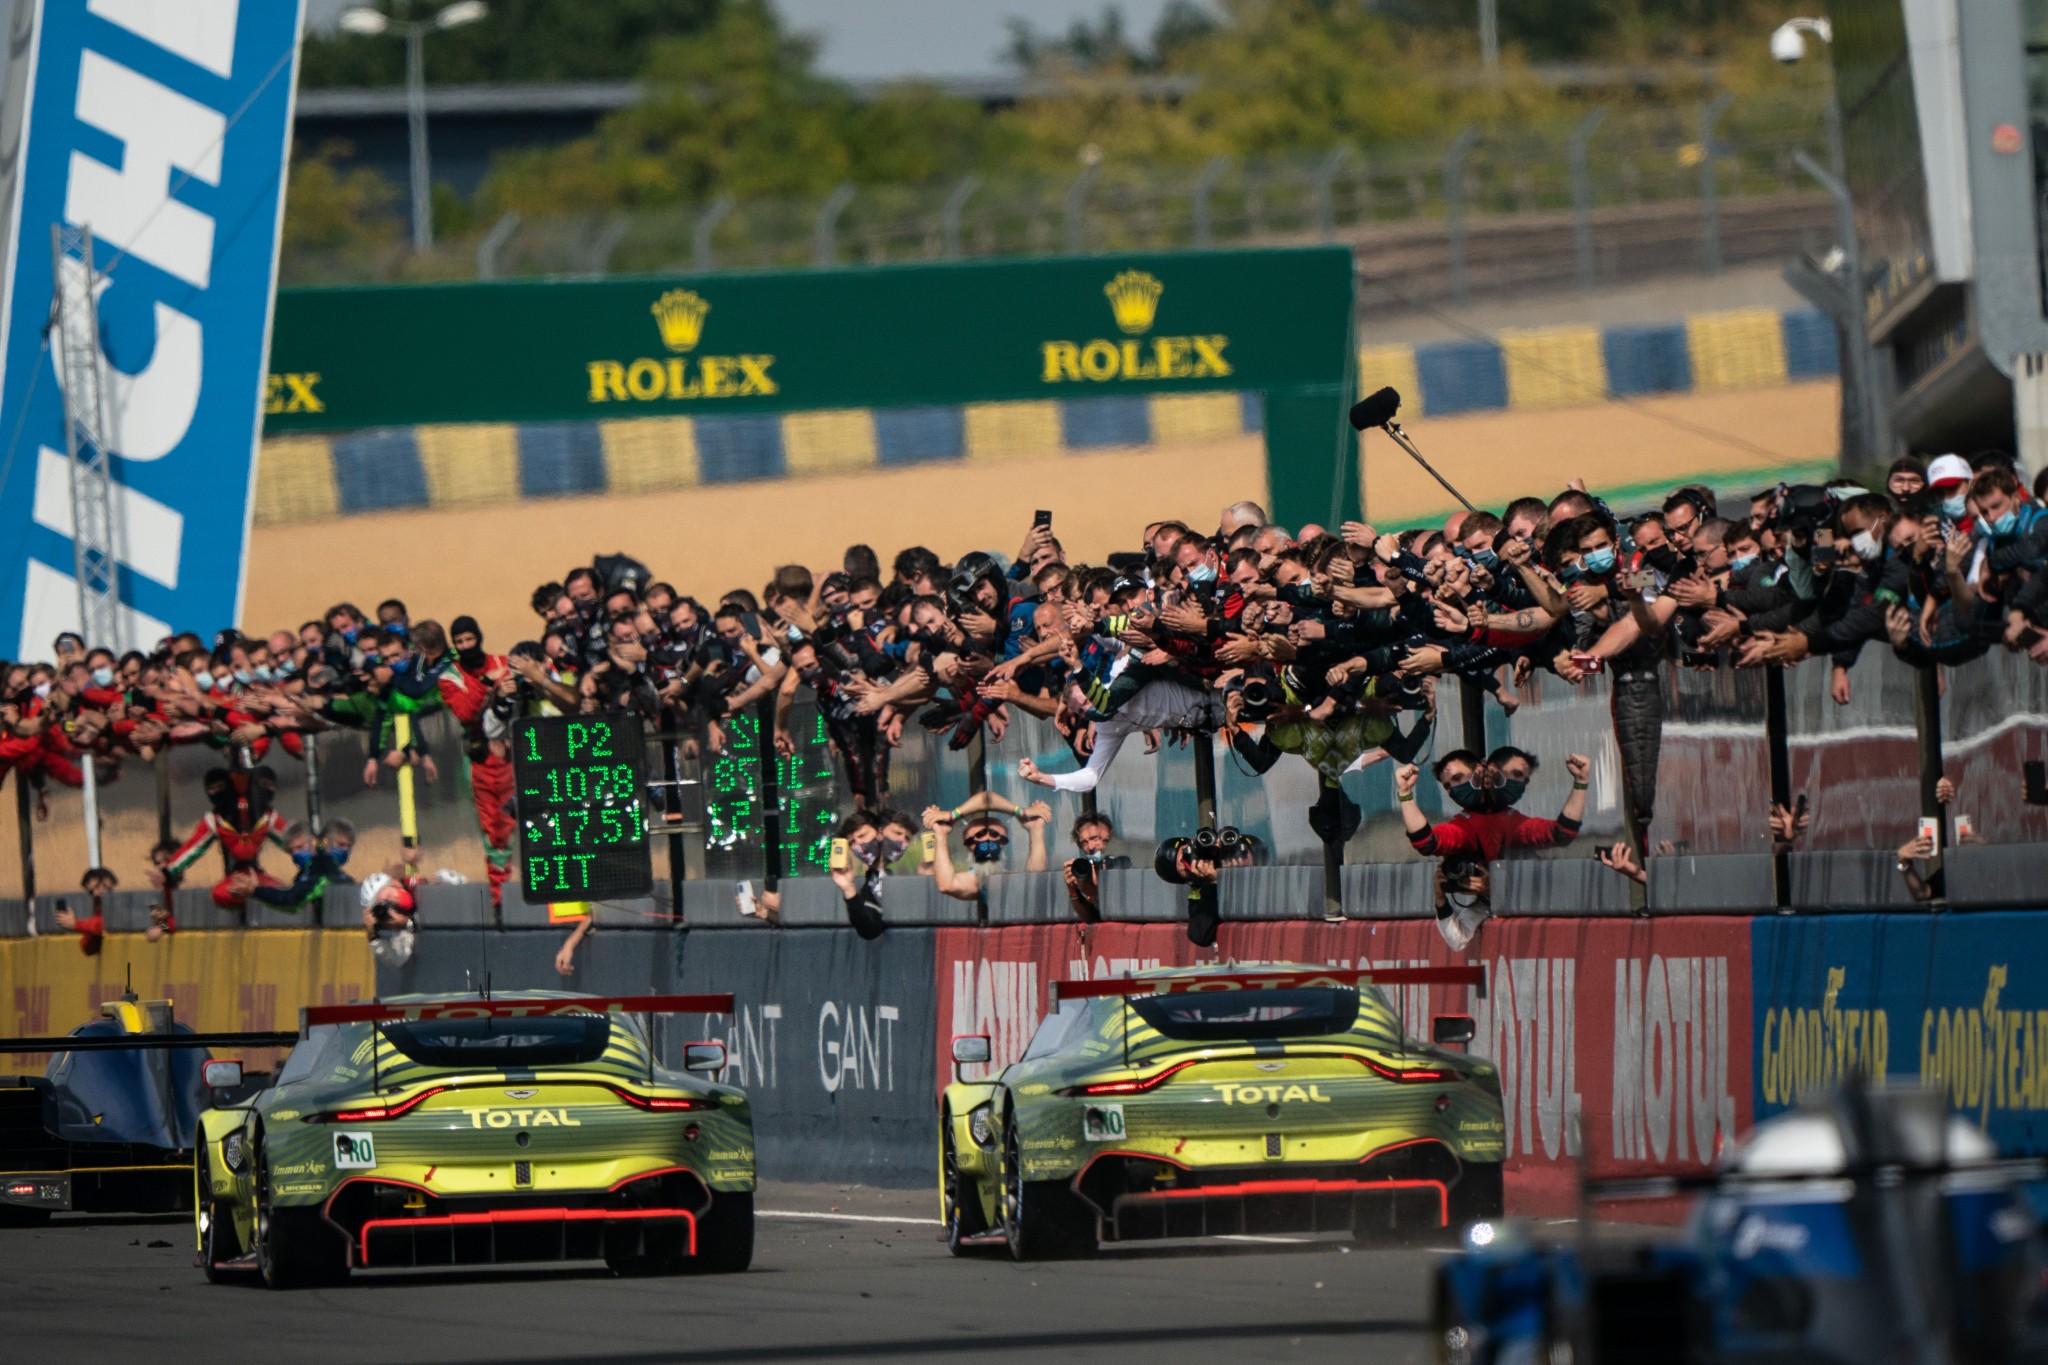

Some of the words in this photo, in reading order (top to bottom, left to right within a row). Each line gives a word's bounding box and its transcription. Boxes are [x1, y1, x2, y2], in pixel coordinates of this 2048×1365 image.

[17, 0, 239, 664] ICH
[587, 354, 780, 402] ROLEX
[1041, 334, 1234, 383] ROLEX
[524, 726, 543, 762] 1
[567, 722, 613, 759] P2
[529, 853, 597, 891] PIT
[818, 1001, 900, 1093] GANT
[1612, 953, 1736, 1166] MOTUL
[462, 1107, 581, 1130] TOTAL
[1213, 1083, 1331, 1106] TOTAL
